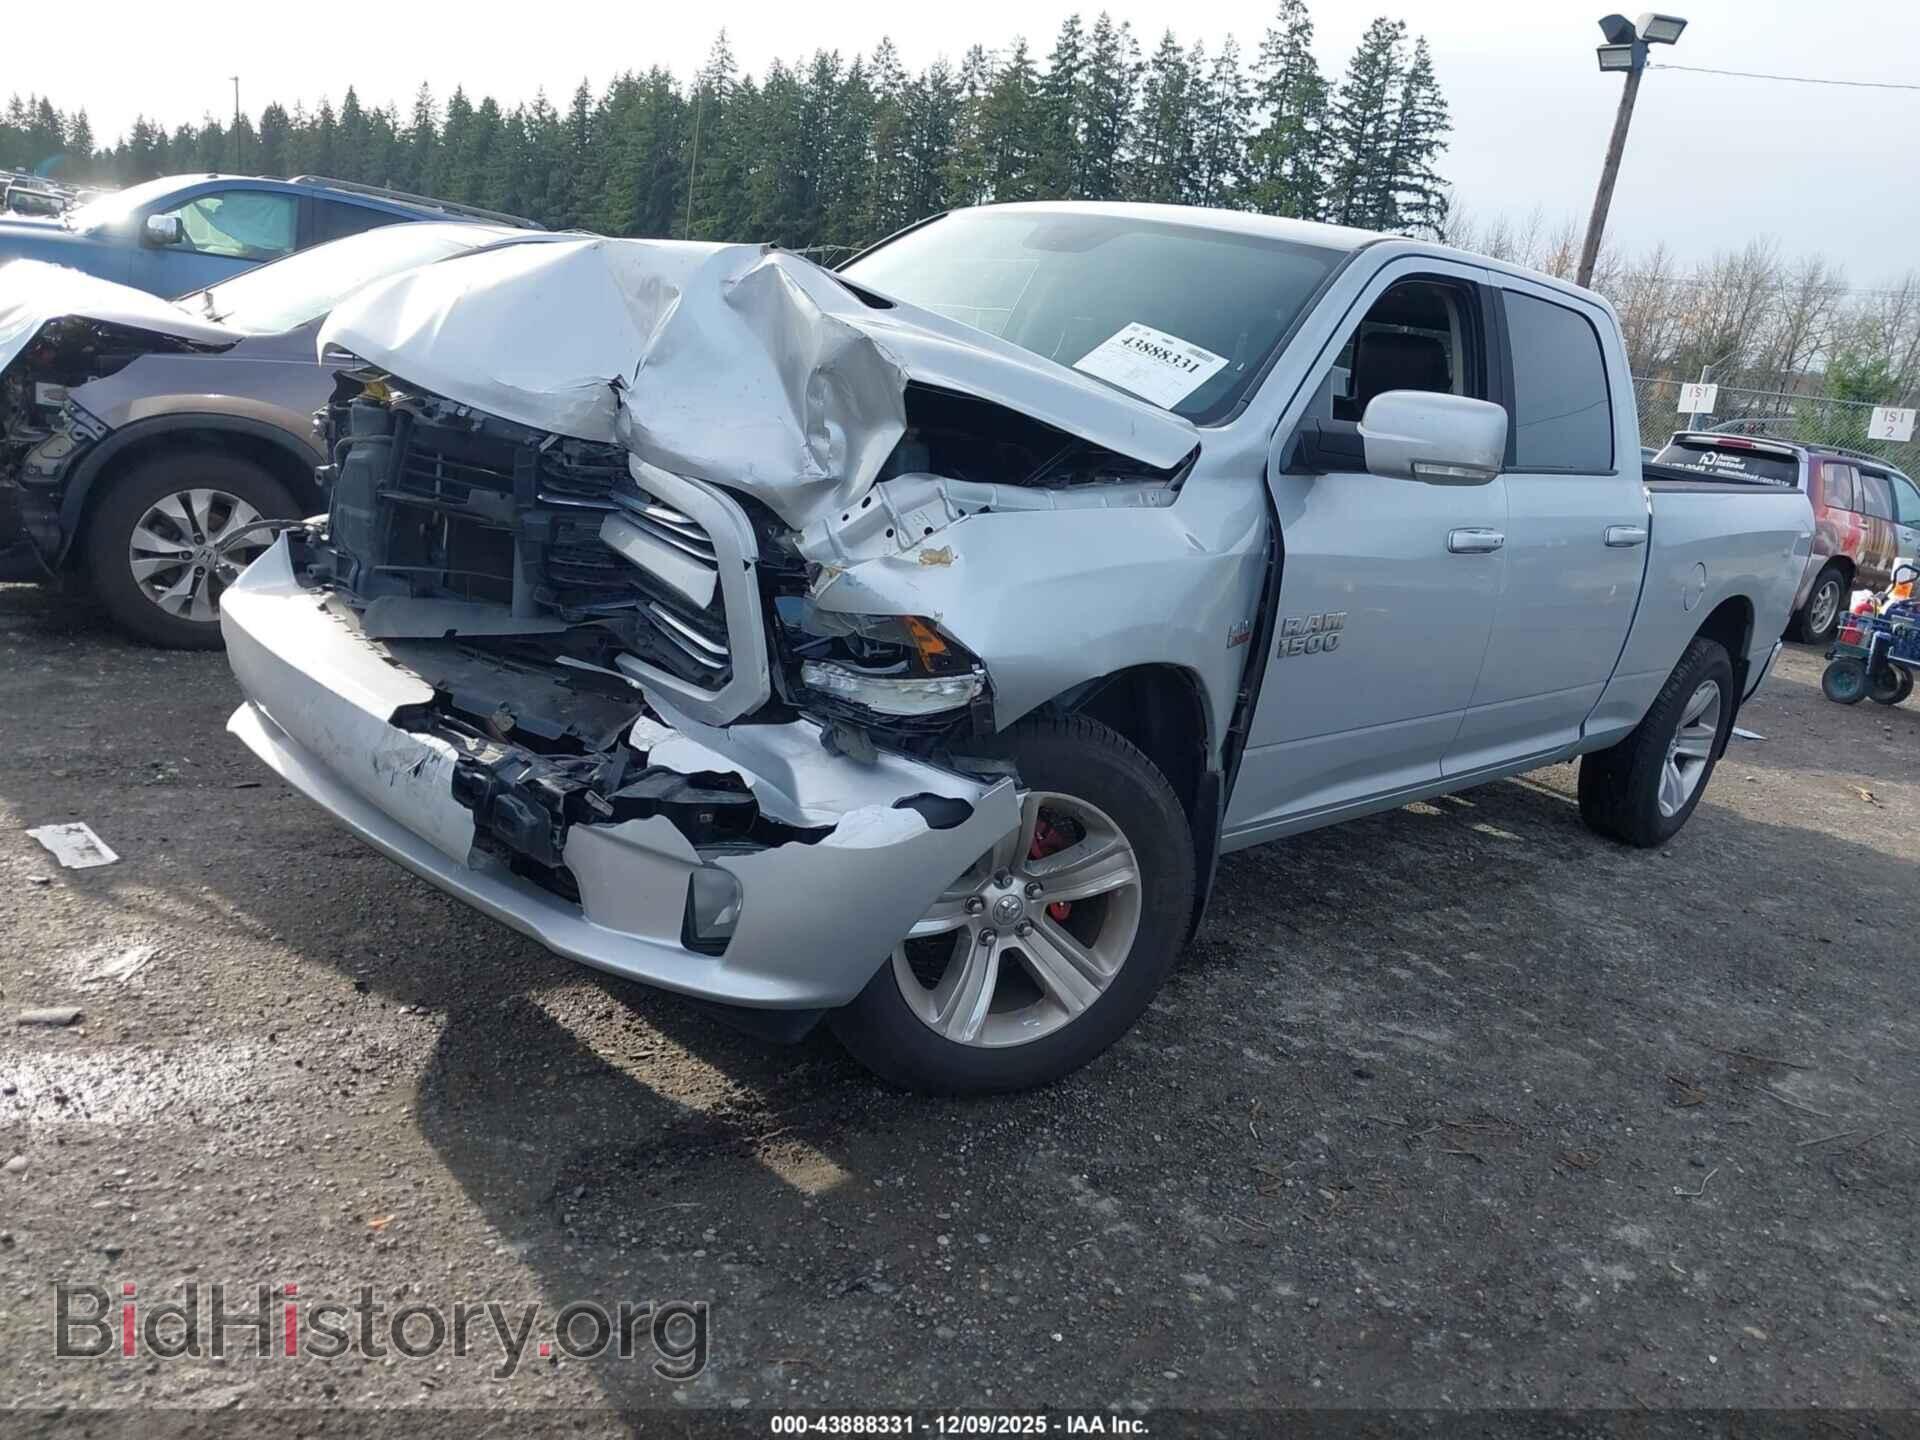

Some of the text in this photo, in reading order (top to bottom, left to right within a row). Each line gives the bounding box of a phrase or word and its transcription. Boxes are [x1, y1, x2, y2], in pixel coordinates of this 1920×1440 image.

[1121, 336, 1201, 374] 43888331
[1886, 426, 1896, 438] 2
[1280, 611, 1348, 637] RAM
[1277, 632, 1341, 658] 1500
